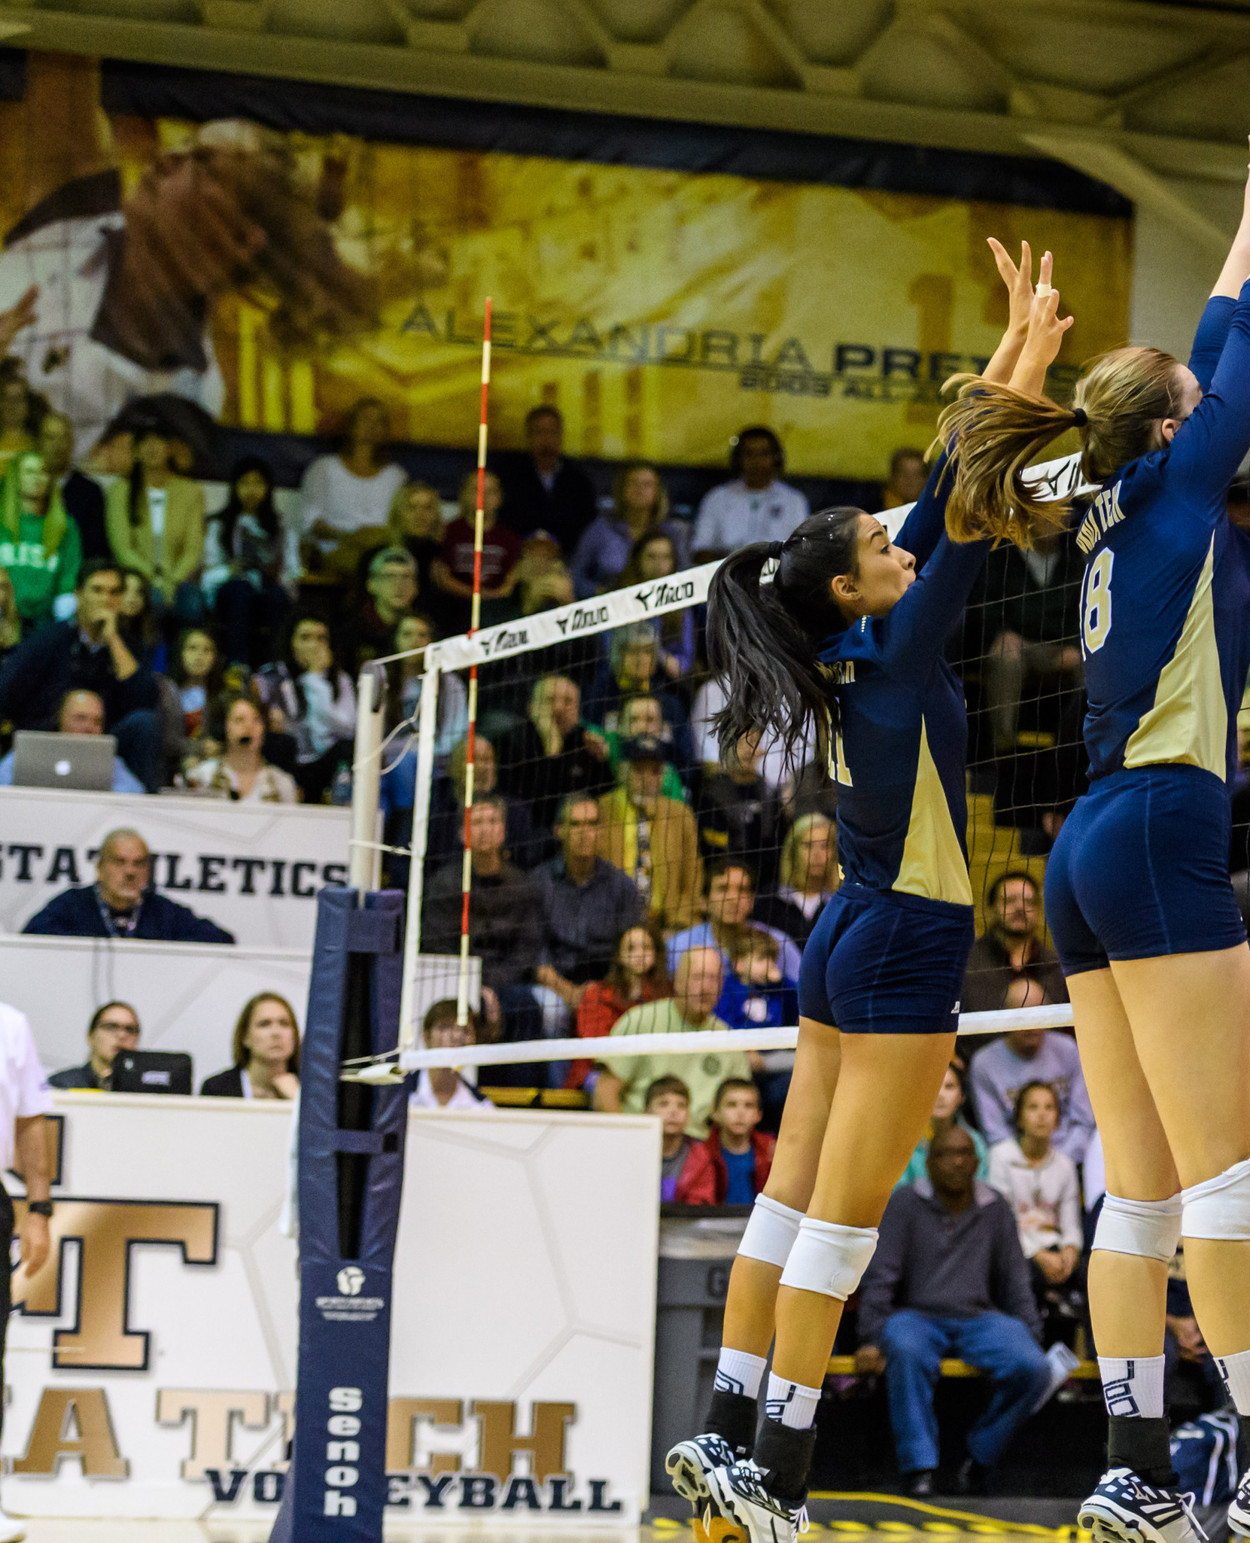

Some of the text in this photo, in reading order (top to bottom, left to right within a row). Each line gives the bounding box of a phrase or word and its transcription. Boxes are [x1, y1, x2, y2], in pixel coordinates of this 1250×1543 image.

[154, 1388, 578, 1485] TCH
[322, 1386, 363, 1518] senoh
[204, 1469, 622, 1511] VOEYBALL
